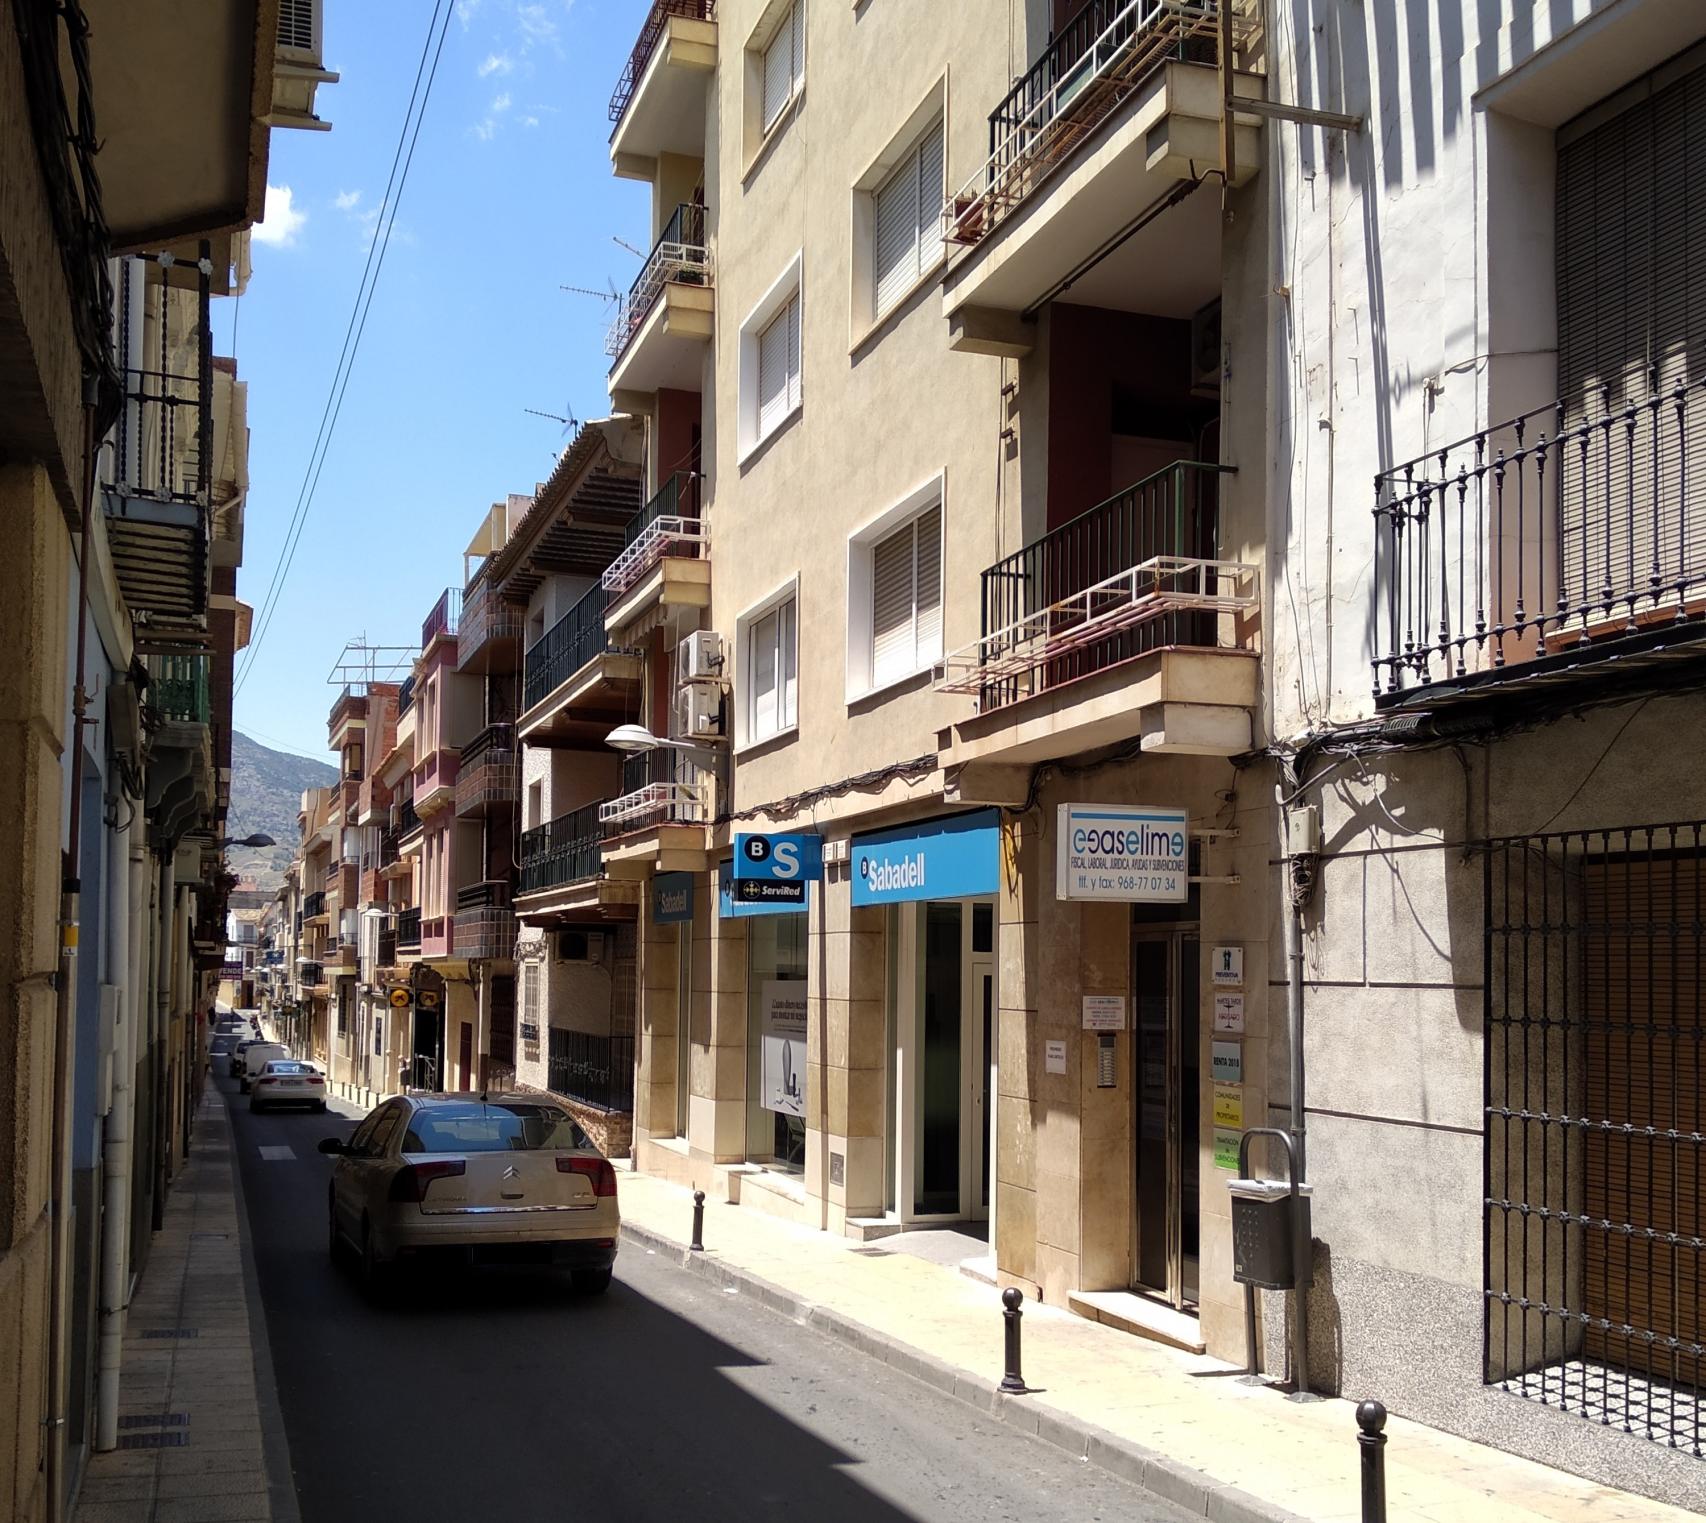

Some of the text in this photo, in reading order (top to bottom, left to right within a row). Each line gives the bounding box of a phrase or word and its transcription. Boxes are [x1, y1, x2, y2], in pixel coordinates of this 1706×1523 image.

[751, 842, 763, 856] B
[772, 842, 800, 878] S
[869, 852, 924, 892] Sabadell
[762, 885, 801, 896] ServiRed
[1091, 878, 1097, 891] y
[1118, 876, 1148, 890] 968-77
[1151, 877, 1162, 890] 07
[1165, 877, 1176, 891] 34
[1213, 1056, 1227, 1066] RENTA
